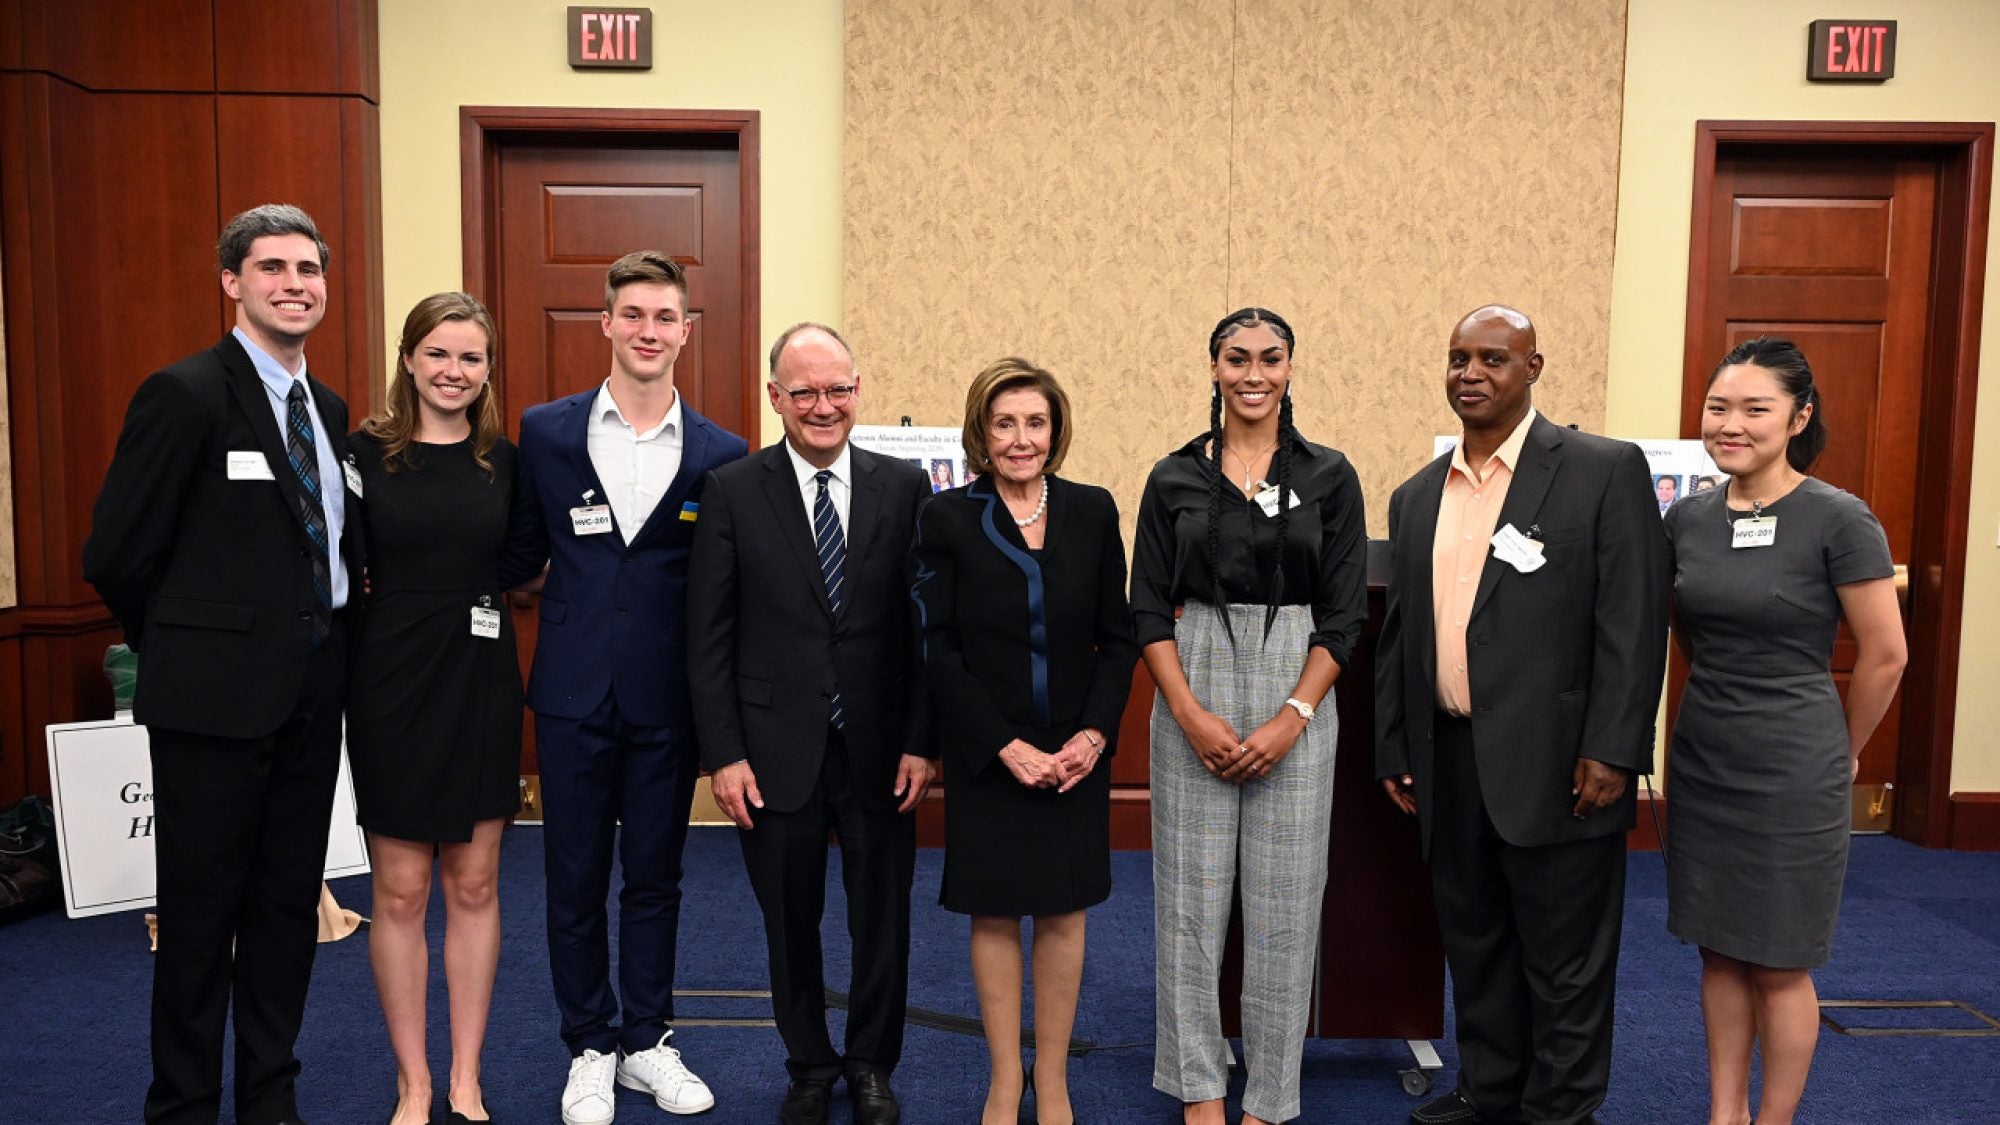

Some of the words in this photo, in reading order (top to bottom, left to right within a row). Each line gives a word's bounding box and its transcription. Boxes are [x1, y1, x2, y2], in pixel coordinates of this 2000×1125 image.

[582, 14, 640, 60] EXIT
[1827, 26, 1887, 72] EXIT
[905, 434, 917, 442] and
[1644, 449, 1672, 457] ngress
[1736, 530, 1772, 538] HVC-201
[128, 815, 155, 839] H
